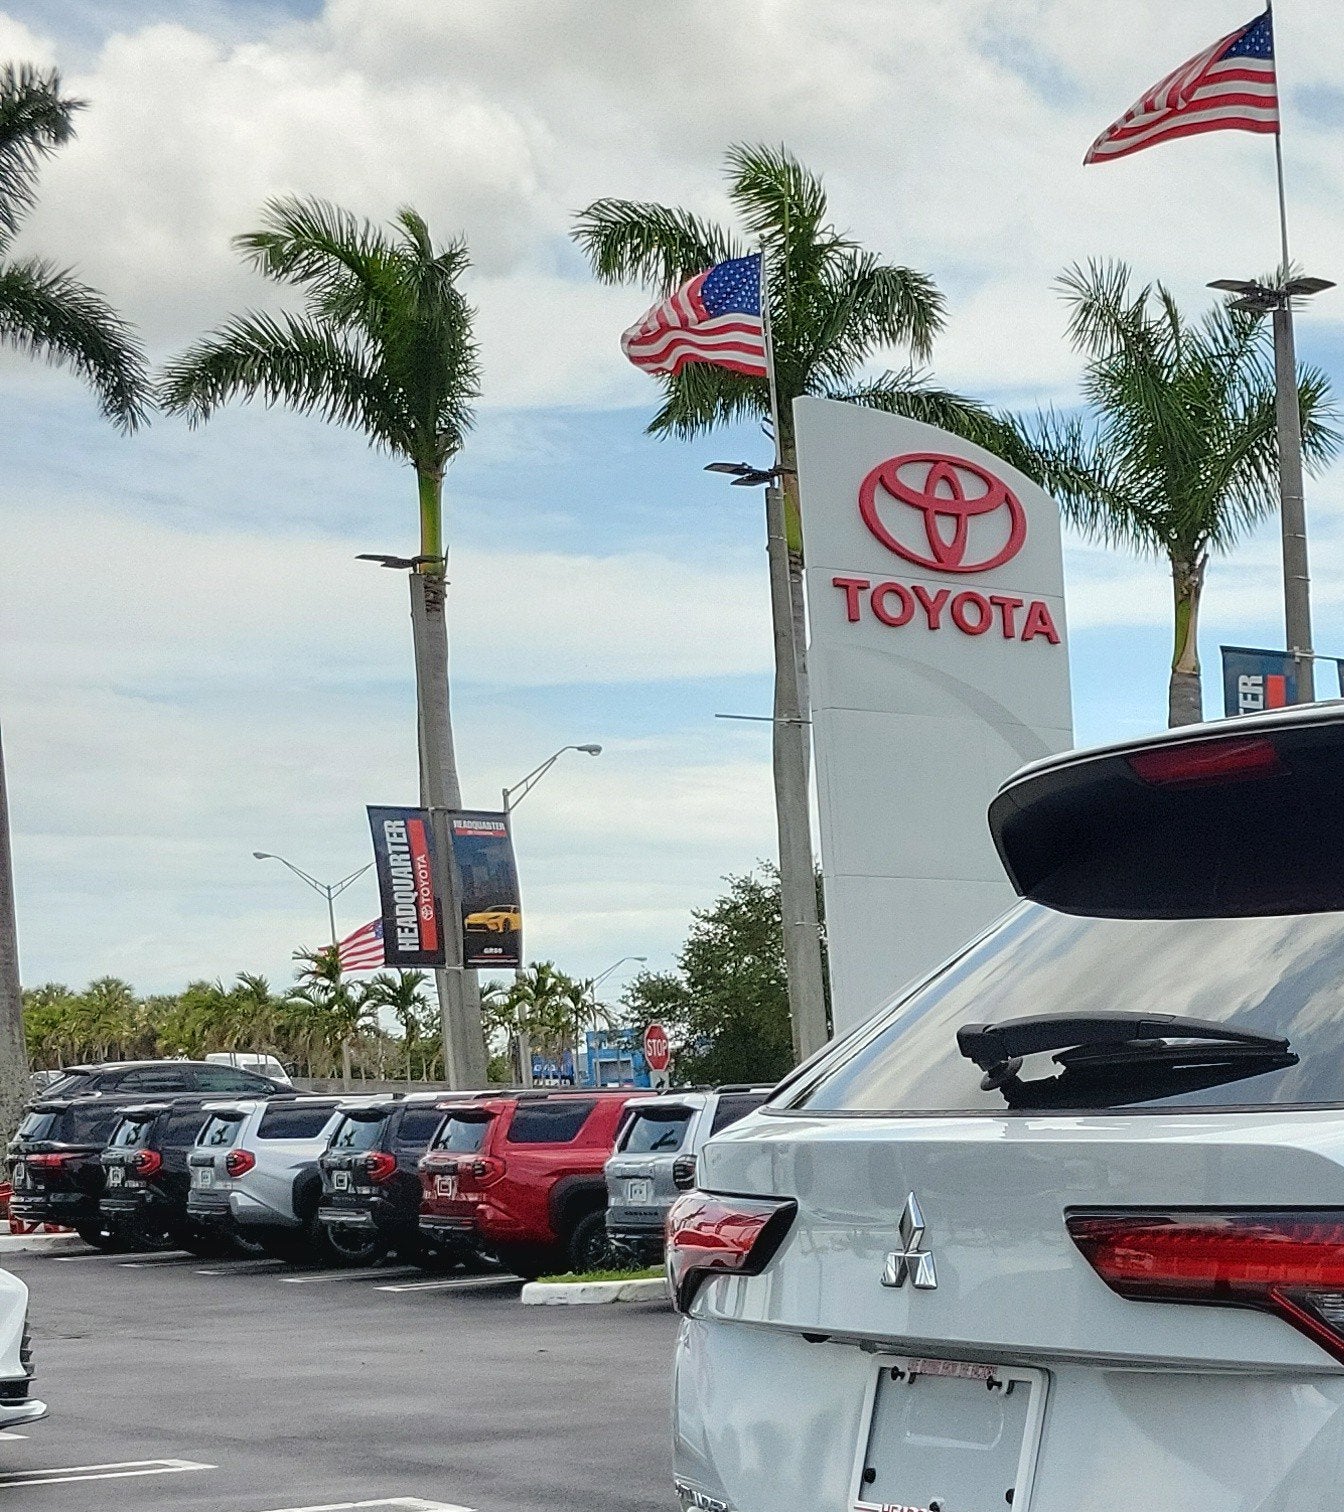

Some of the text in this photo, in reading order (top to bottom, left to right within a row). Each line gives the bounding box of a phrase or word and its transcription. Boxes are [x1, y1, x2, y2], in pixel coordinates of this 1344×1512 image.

[832, 577, 1061, 644] TOYOTA
[453, 820, 505, 830] HEADQUARTER
[384, 820, 420, 951] HEADQUARTER
[416, 855, 431, 903] TOYOTA
[647, 1039, 667, 1057] STOP
